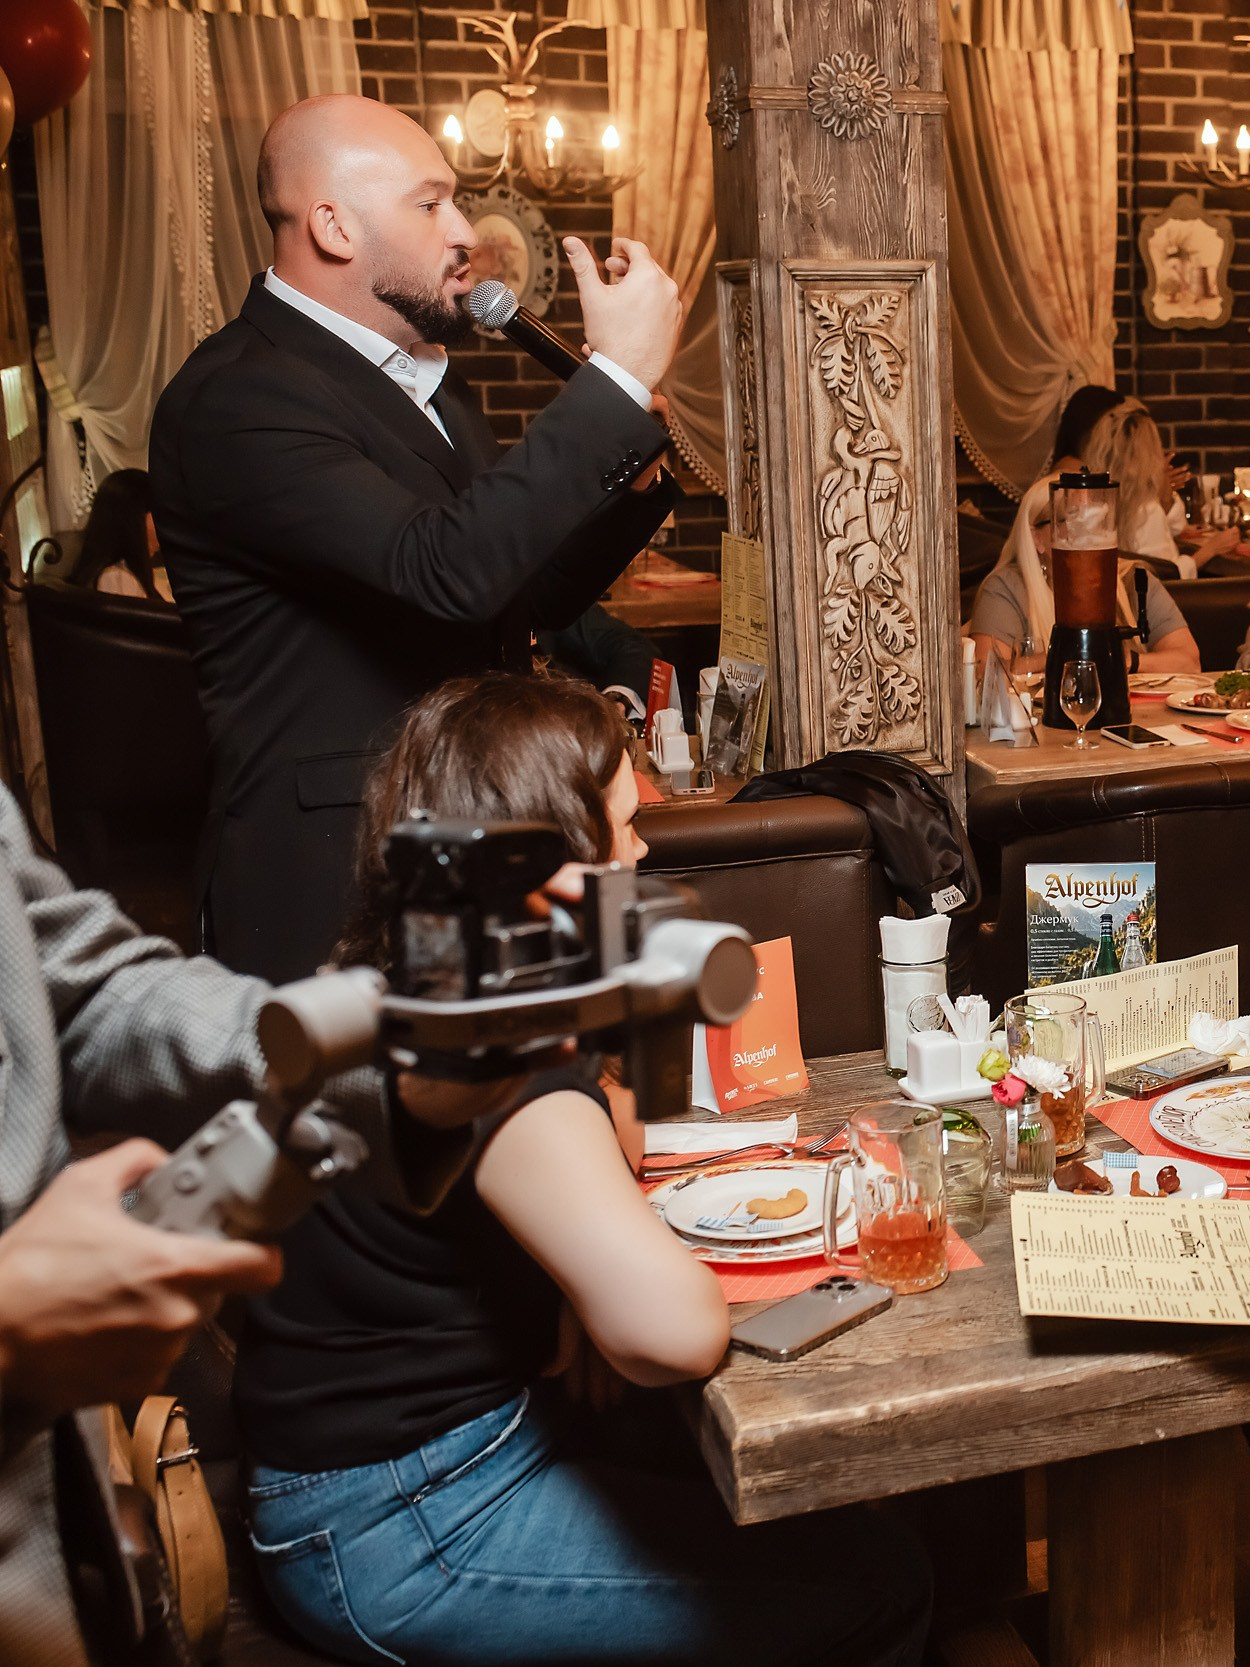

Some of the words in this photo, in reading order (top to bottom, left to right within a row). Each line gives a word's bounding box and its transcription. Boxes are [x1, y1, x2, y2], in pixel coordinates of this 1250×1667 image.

[726, 663, 760, 689] Alpenhof
[1044, 872, 1140, 908] Alpenhof
[1030, 914, 1079, 927] Джермук
[733, 1043, 777, 1068] Alpenhof
